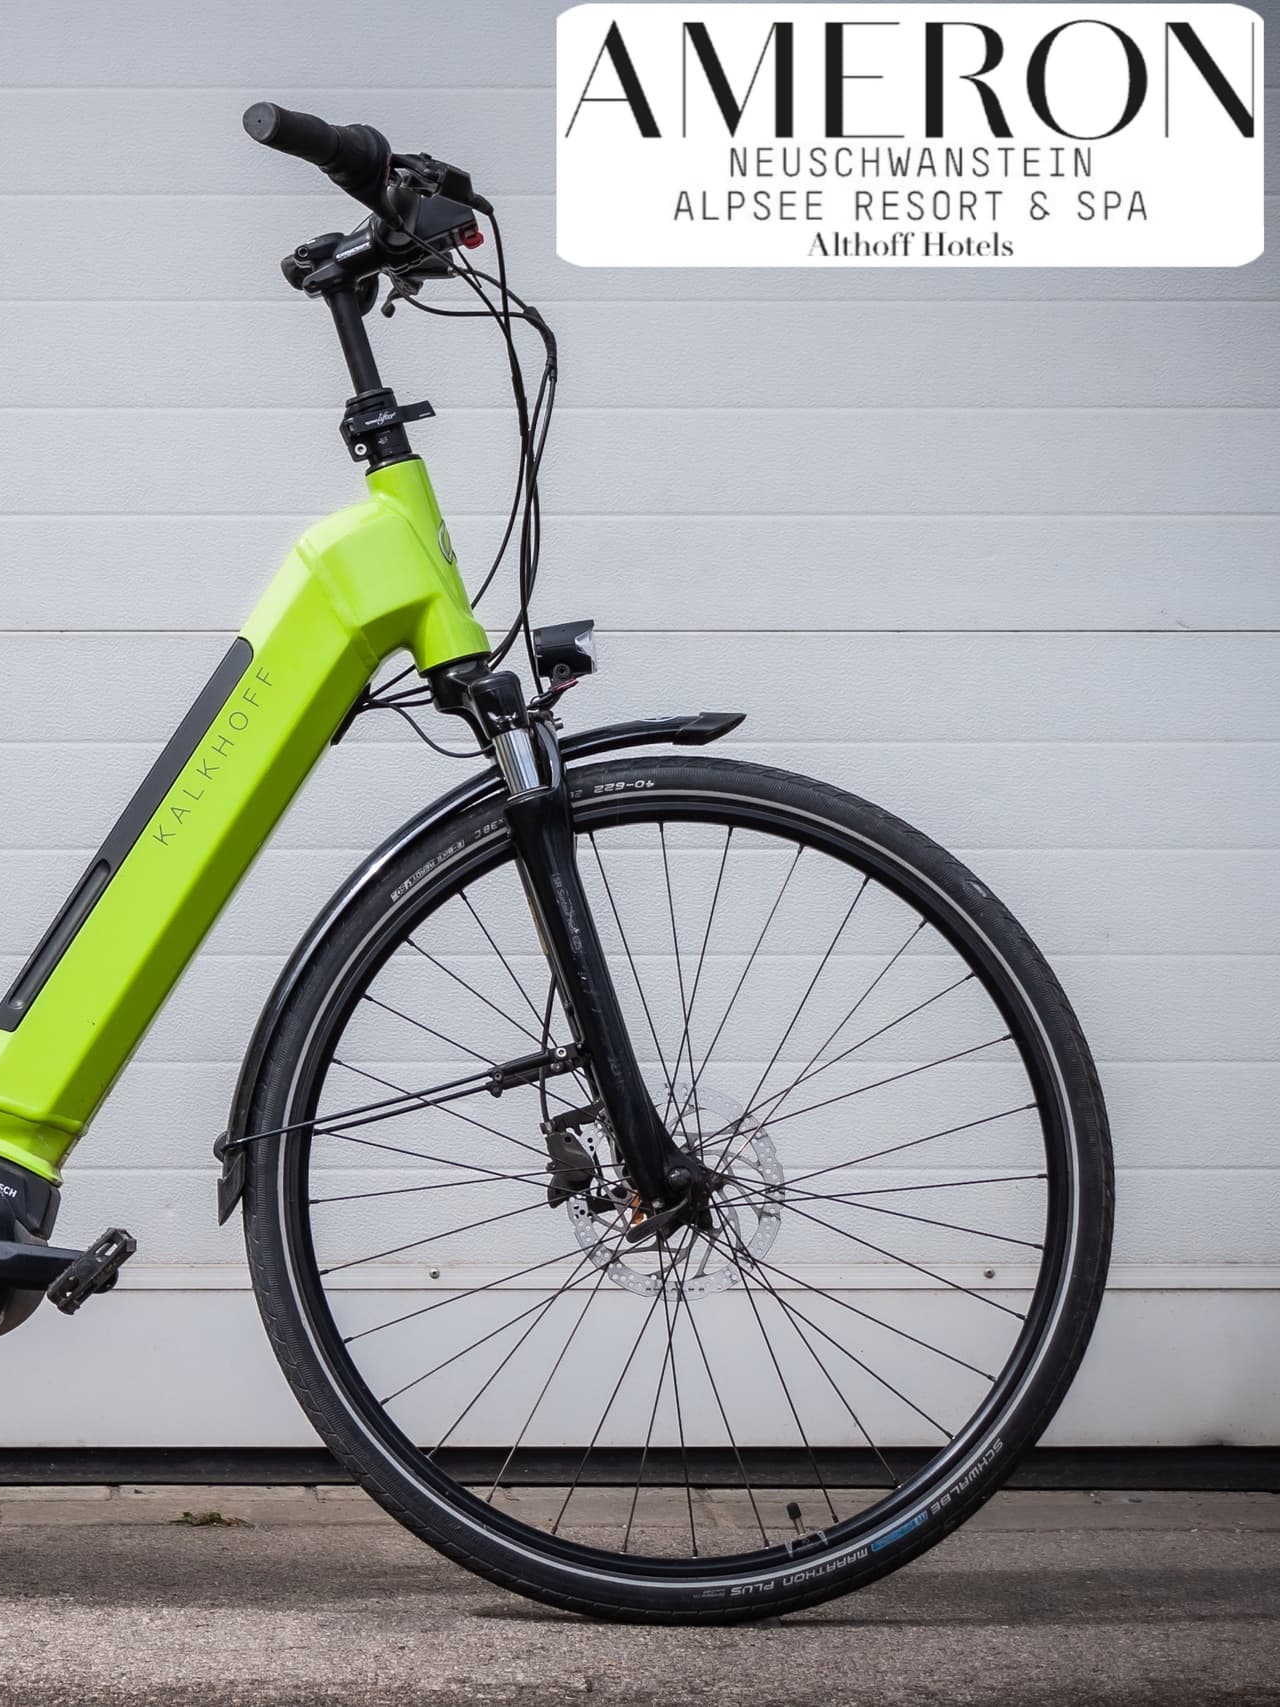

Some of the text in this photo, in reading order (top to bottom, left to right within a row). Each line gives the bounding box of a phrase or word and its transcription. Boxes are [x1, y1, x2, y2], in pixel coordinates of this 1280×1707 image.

[152, 666, 274, 846] KALKHOFF
[593, 779, 655, 794] 40-622
[931, 1438, 1005, 1515] SCHWALBE
[729, 1547, 869, 1597] MARATHON PLUS
